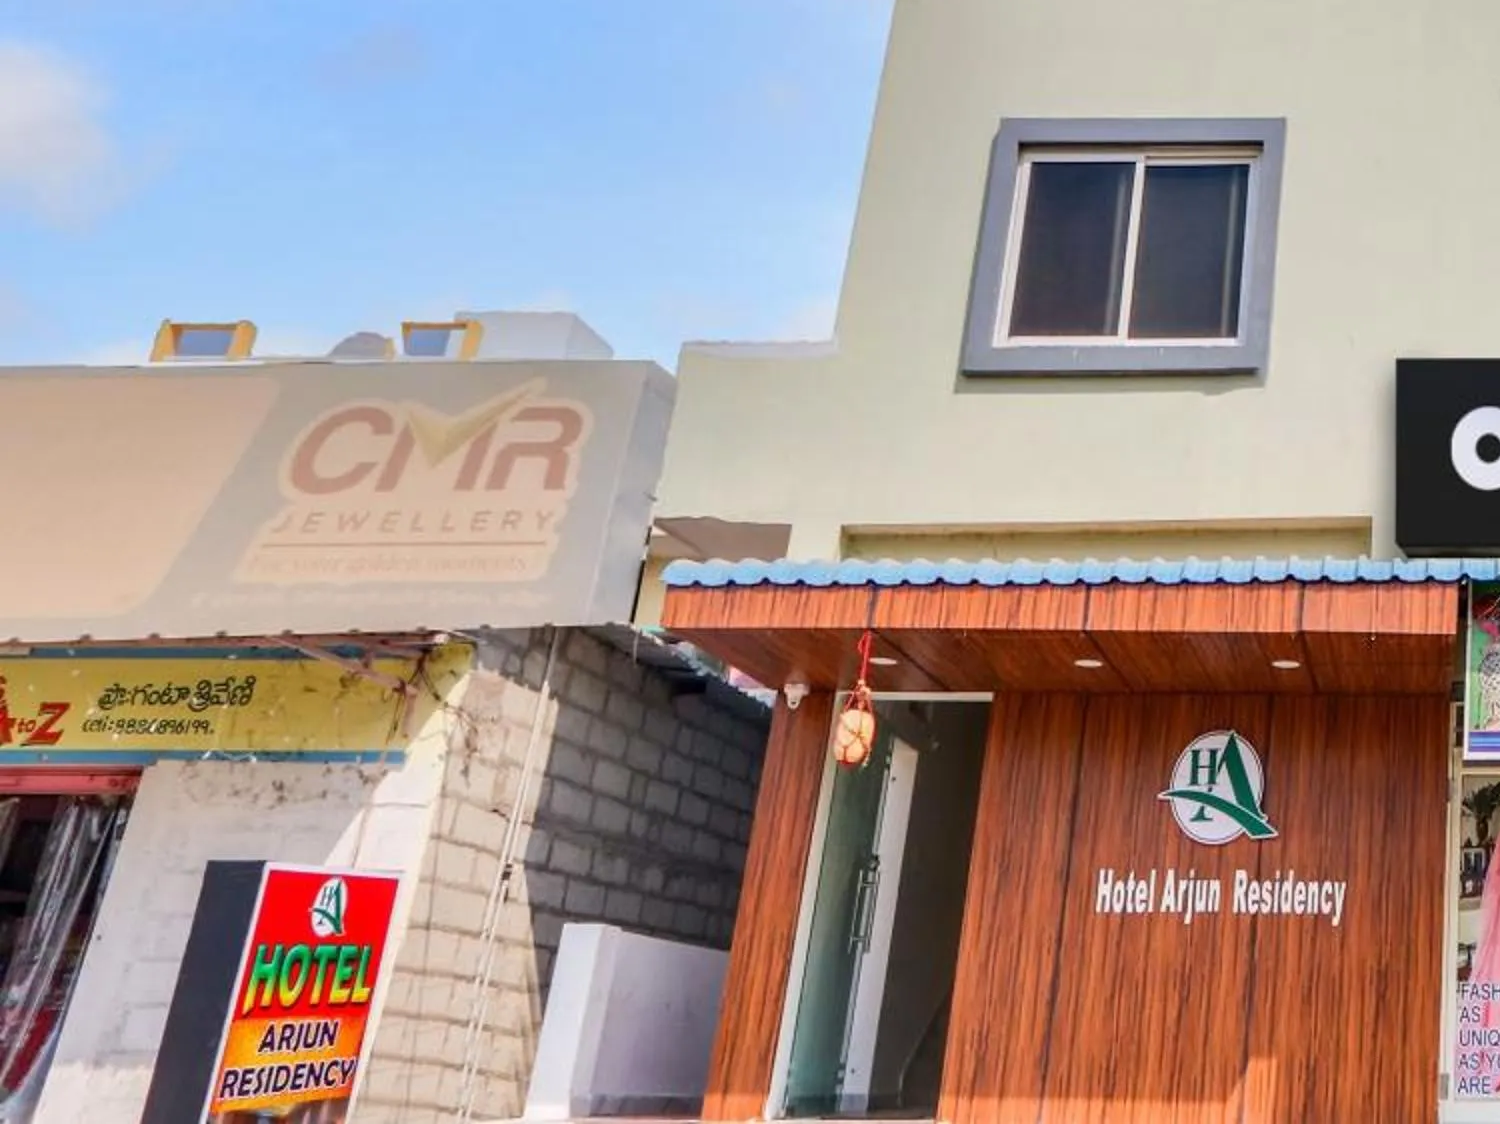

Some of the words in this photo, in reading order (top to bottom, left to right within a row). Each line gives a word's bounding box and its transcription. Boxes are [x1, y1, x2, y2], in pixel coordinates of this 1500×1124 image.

[290, 378, 584, 496] CMR
[271, 509, 556, 535] JEWELLERY
[18, 719, 36, 733] to
[22, 702, 71, 746] Z
[1096, 869, 1156, 913] Hotel
[1161, 869, 1220, 924] Arjun
[1233, 870, 1346, 926] Residency
[243, 945, 372, 1015] HOTEL
[1459, 1006, 1481, 1023] AS
[258, 1022, 339, 1053] ARJUN
[1459, 1052, 1480, 1070] AS
[219, 1059, 357, 1099] RESIDENCY
[1457, 1076, 1492, 1094] ARE
